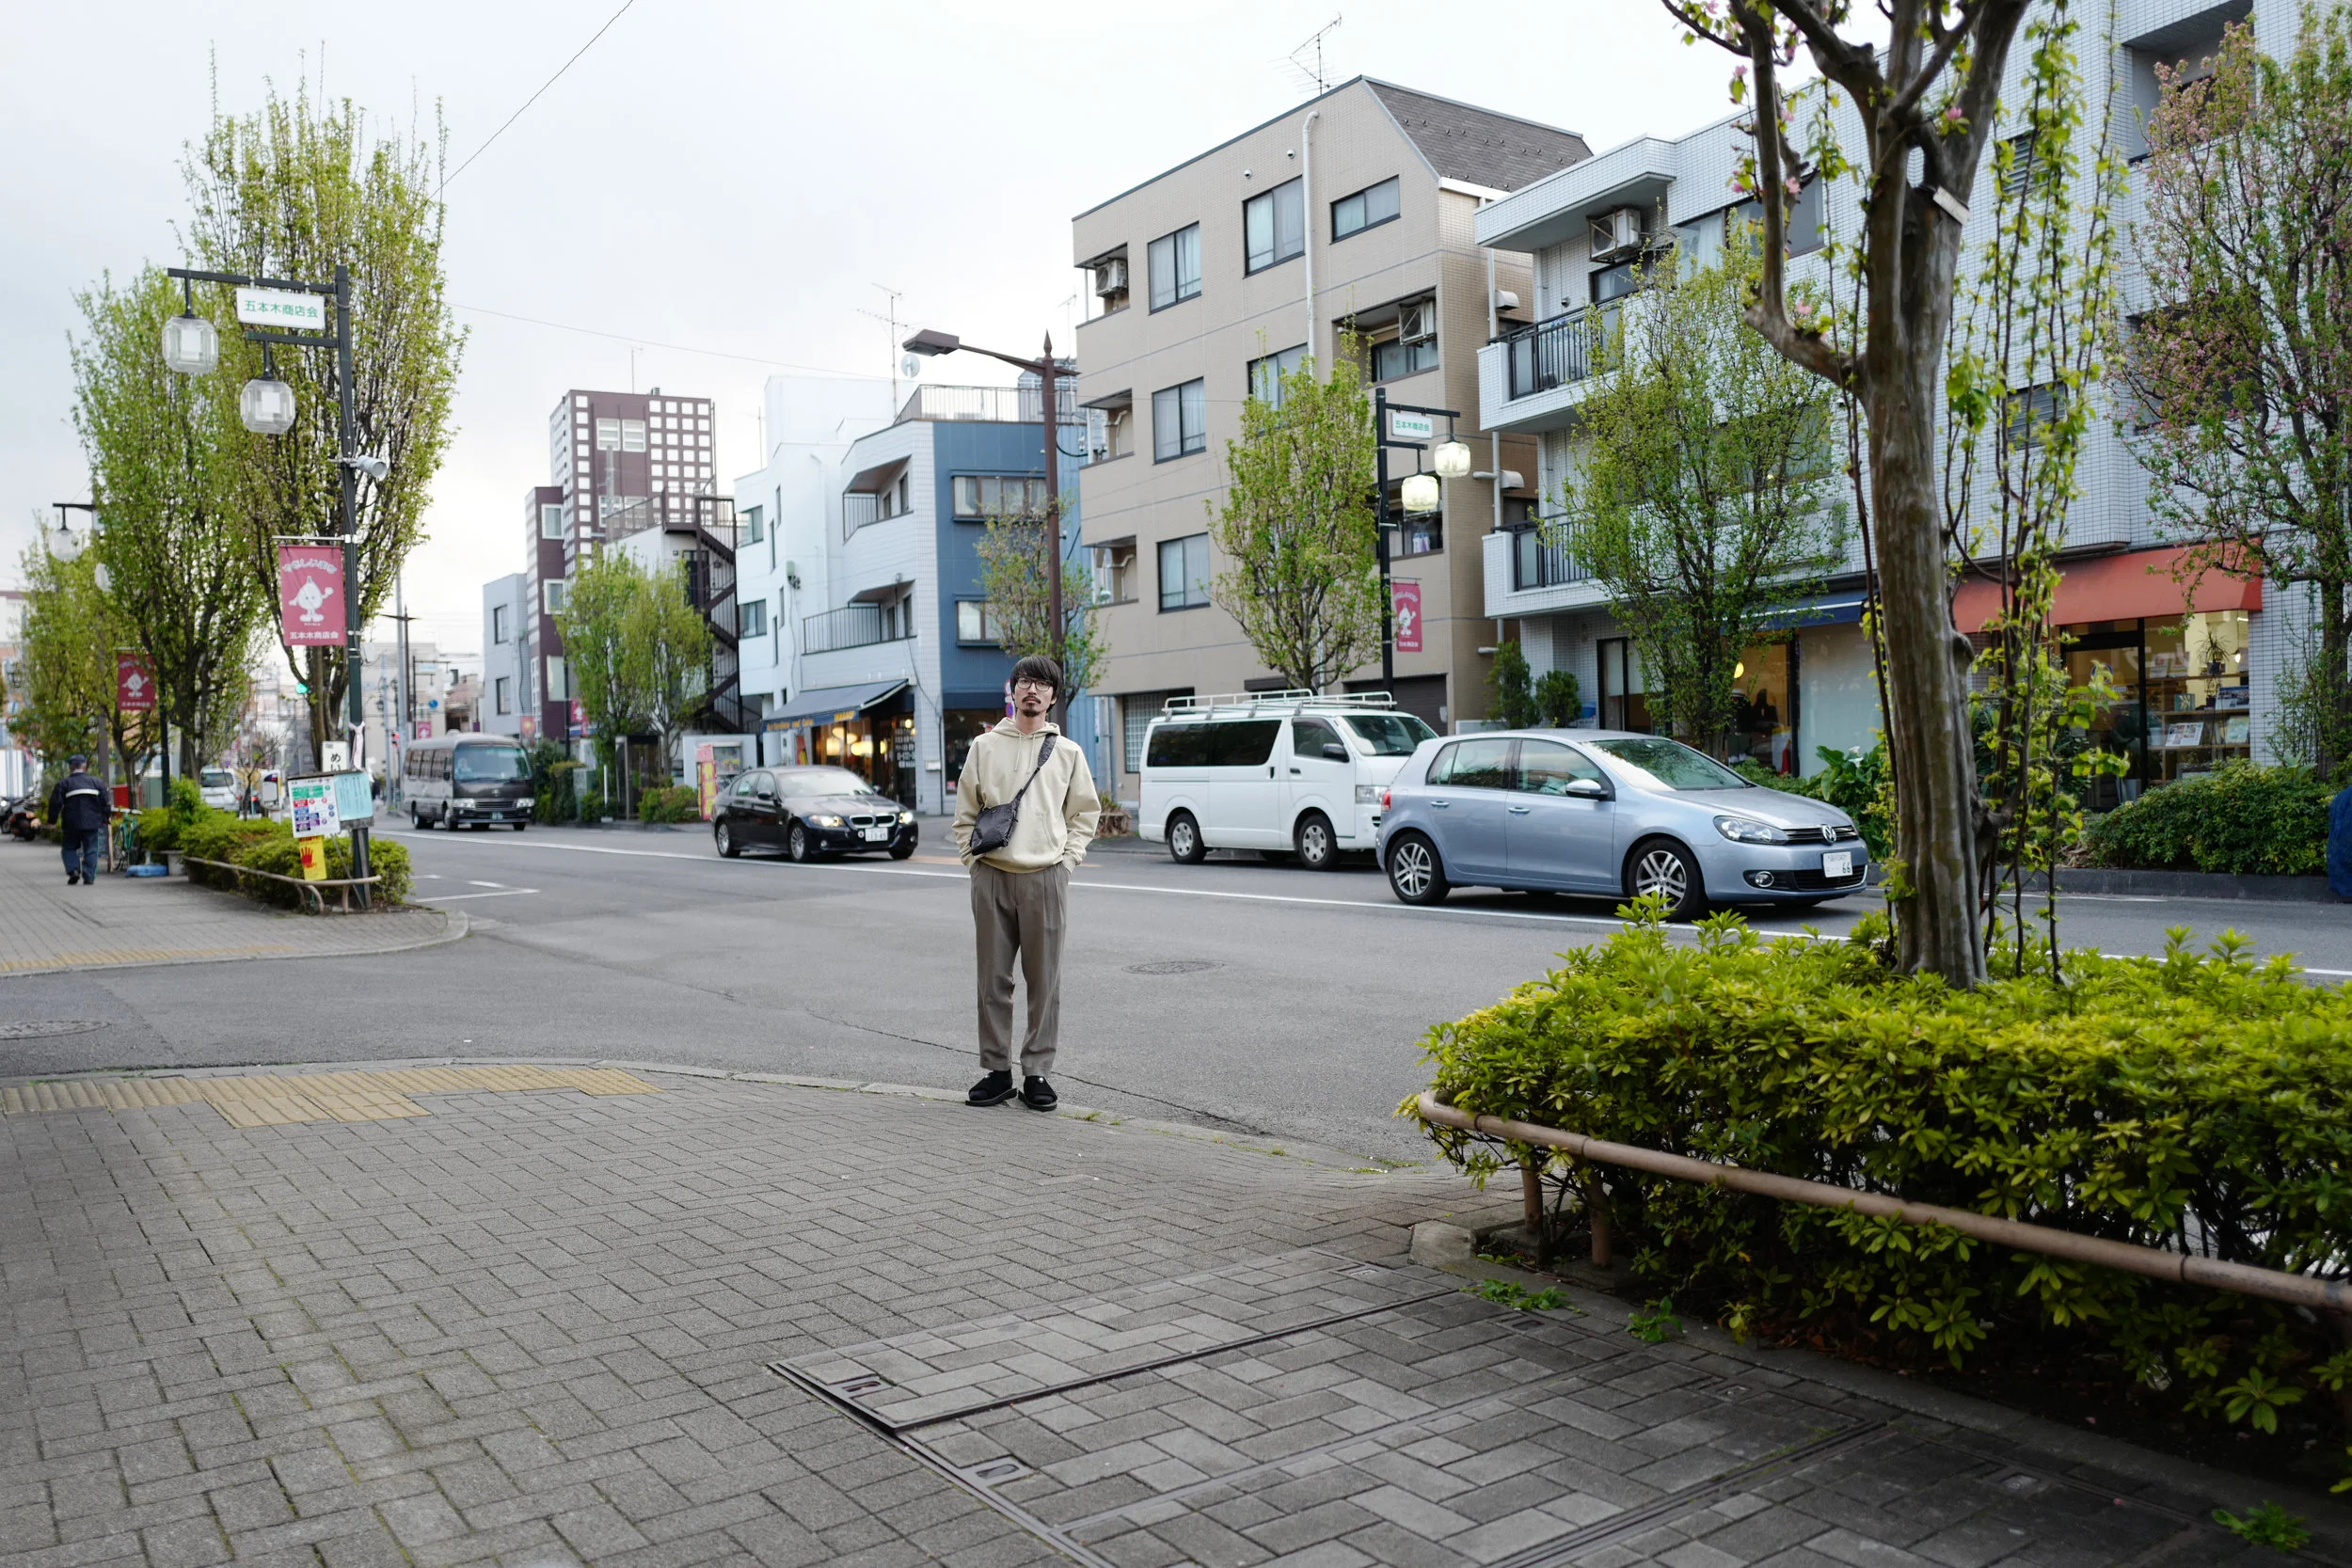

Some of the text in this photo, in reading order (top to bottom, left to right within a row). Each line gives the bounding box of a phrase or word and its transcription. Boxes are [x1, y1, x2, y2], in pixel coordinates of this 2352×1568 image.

[245, 300, 318, 318] 五本木商店会
[290, 631, 339, 640] 五本木商店会
